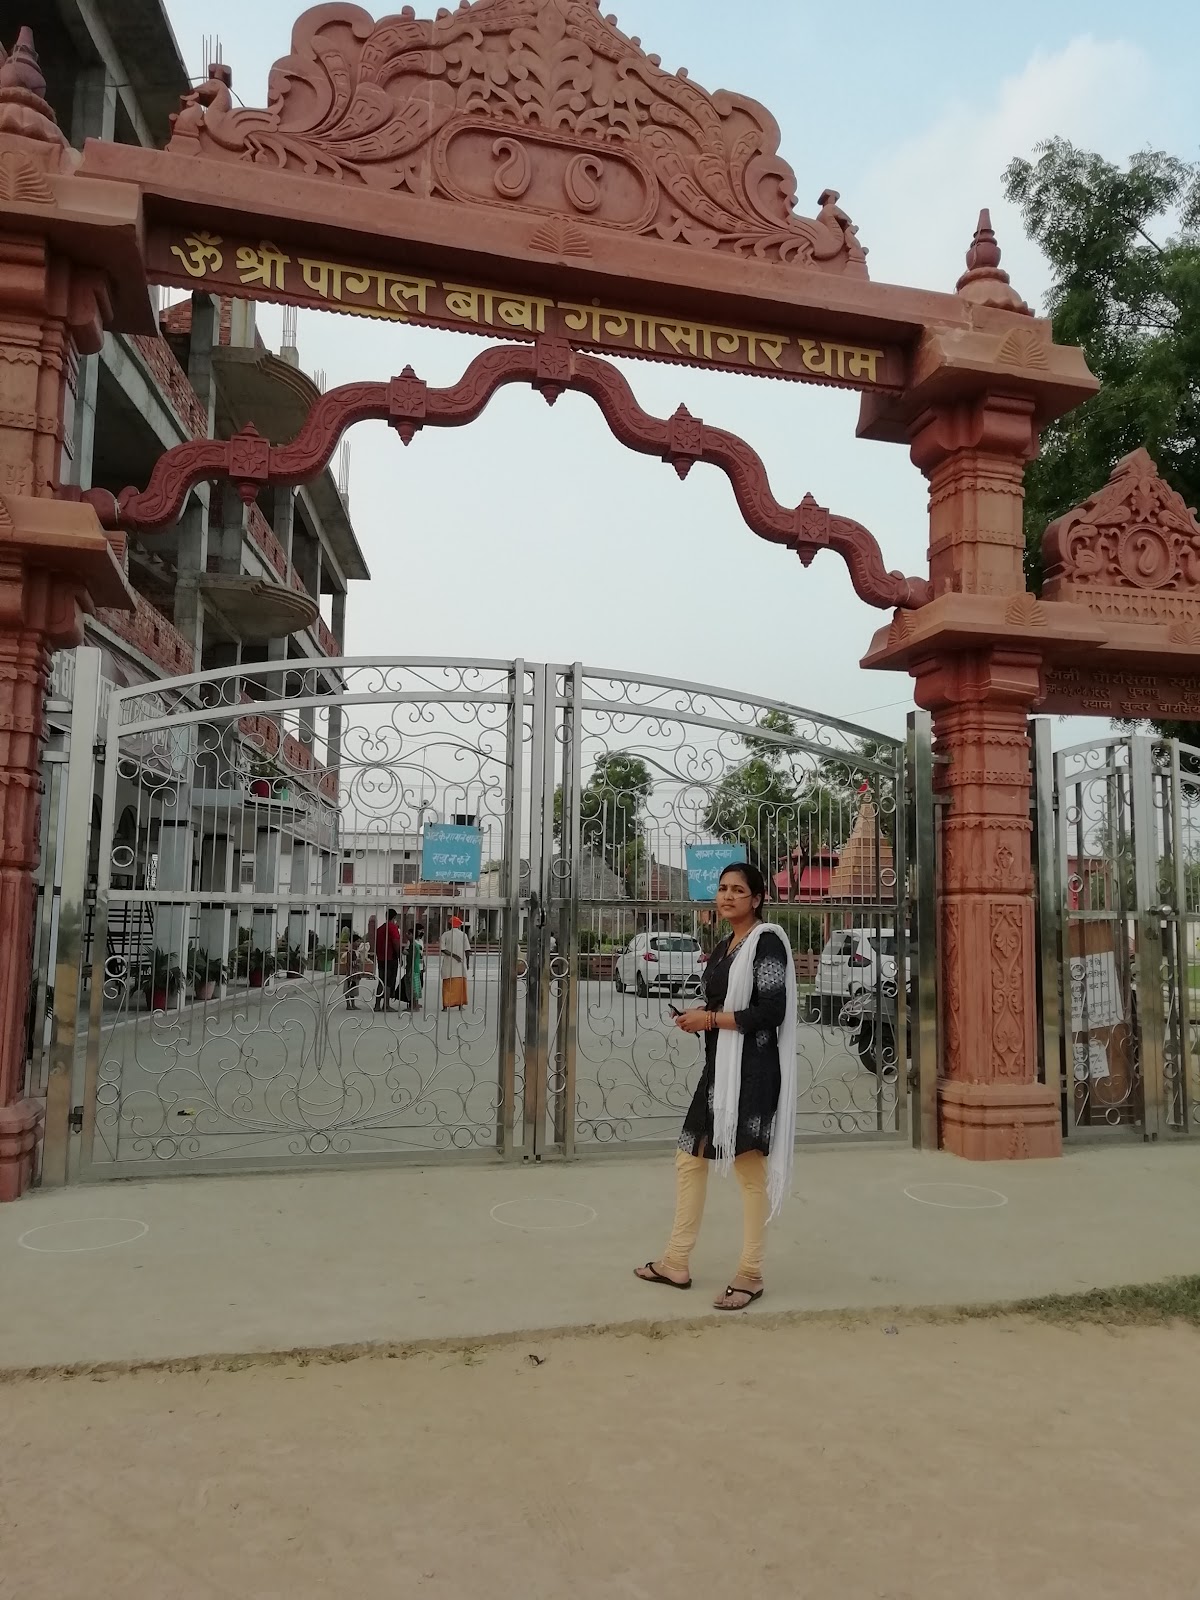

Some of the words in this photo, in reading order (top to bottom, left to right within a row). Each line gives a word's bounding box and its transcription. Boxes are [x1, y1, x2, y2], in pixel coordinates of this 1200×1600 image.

[235, 240, 291, 290] श्री
[298, 257, 437, 314] पागल
[442, 281, 555, 334] बाबा
[557, 297, 791, 369] गंगासागर
[798, 338, 884, 383] धाम
[1082, 699, 1112, 709] श्याम
[1120, 701, 1151, 713] सुन्दर
